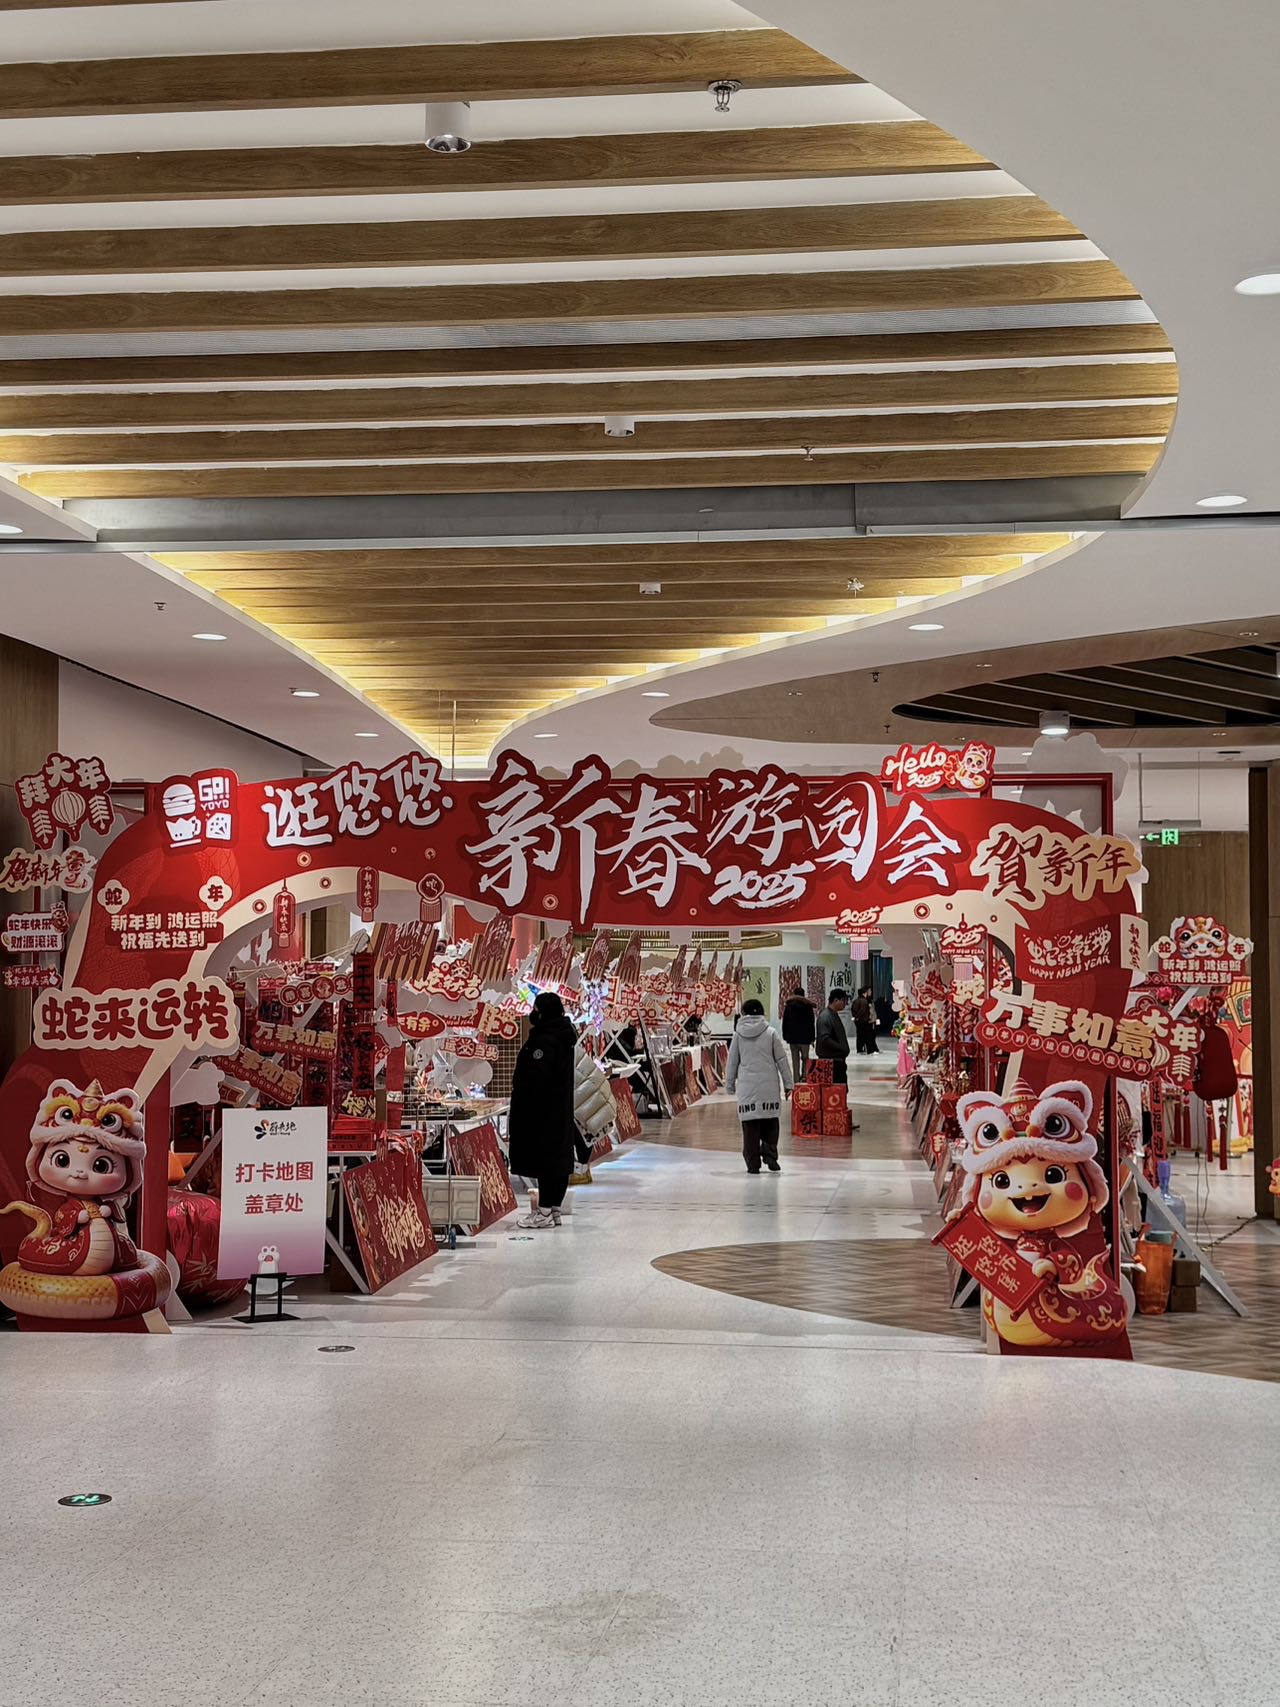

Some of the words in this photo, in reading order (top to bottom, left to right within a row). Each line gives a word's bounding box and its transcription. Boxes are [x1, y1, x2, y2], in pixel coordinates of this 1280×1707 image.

[886, 747, 946, 790] Hello
[19, 756, 106, 809] 拜大年
[908, 772, 942, 788] 2025
[200, 799, 230, 811] YOYO
[260, 755, 453, 847] 逛悠悠
[465, 758, 962, 924] 新春游园会
[207, 884, 224, 903] 年
[708, 860, 817, 909] 2025
[104, 887, 123, 907] 蛇
[8, 914, 52, 931] 蛇年快乐
[111, 913, 162, 932] 新年到
[167, 911, 219, 930] 鸿运照
[838, 906, 884, 926] 2025
[11, 932, 60, 950] 财源滚滚
[120, 931, 206, 950] 祝福先送到
[942, 926, 986, 948] 2025
[1233, 942, 1246, 954] 年
[1028, 965, 1054, 980] HAPPY
[1056, 962, 1082, 979] NEW
[1084, 954, 1111, 971] YEAR
[1162, 959, 1201, 971] 新年到
[41, 982, 230, 1042] 蛇来运转
[254, 1020, 337, 1050] 万事如意
[985, 988, 1158, 1060] 万事如意
[1143, 1009, 1199, 1052] 大年
[233, 1044, 302, 1095] 事如意
[236, 1161, 314, 1184] 打卡地图
[244, 1193, 304, 1214] 盖章处
